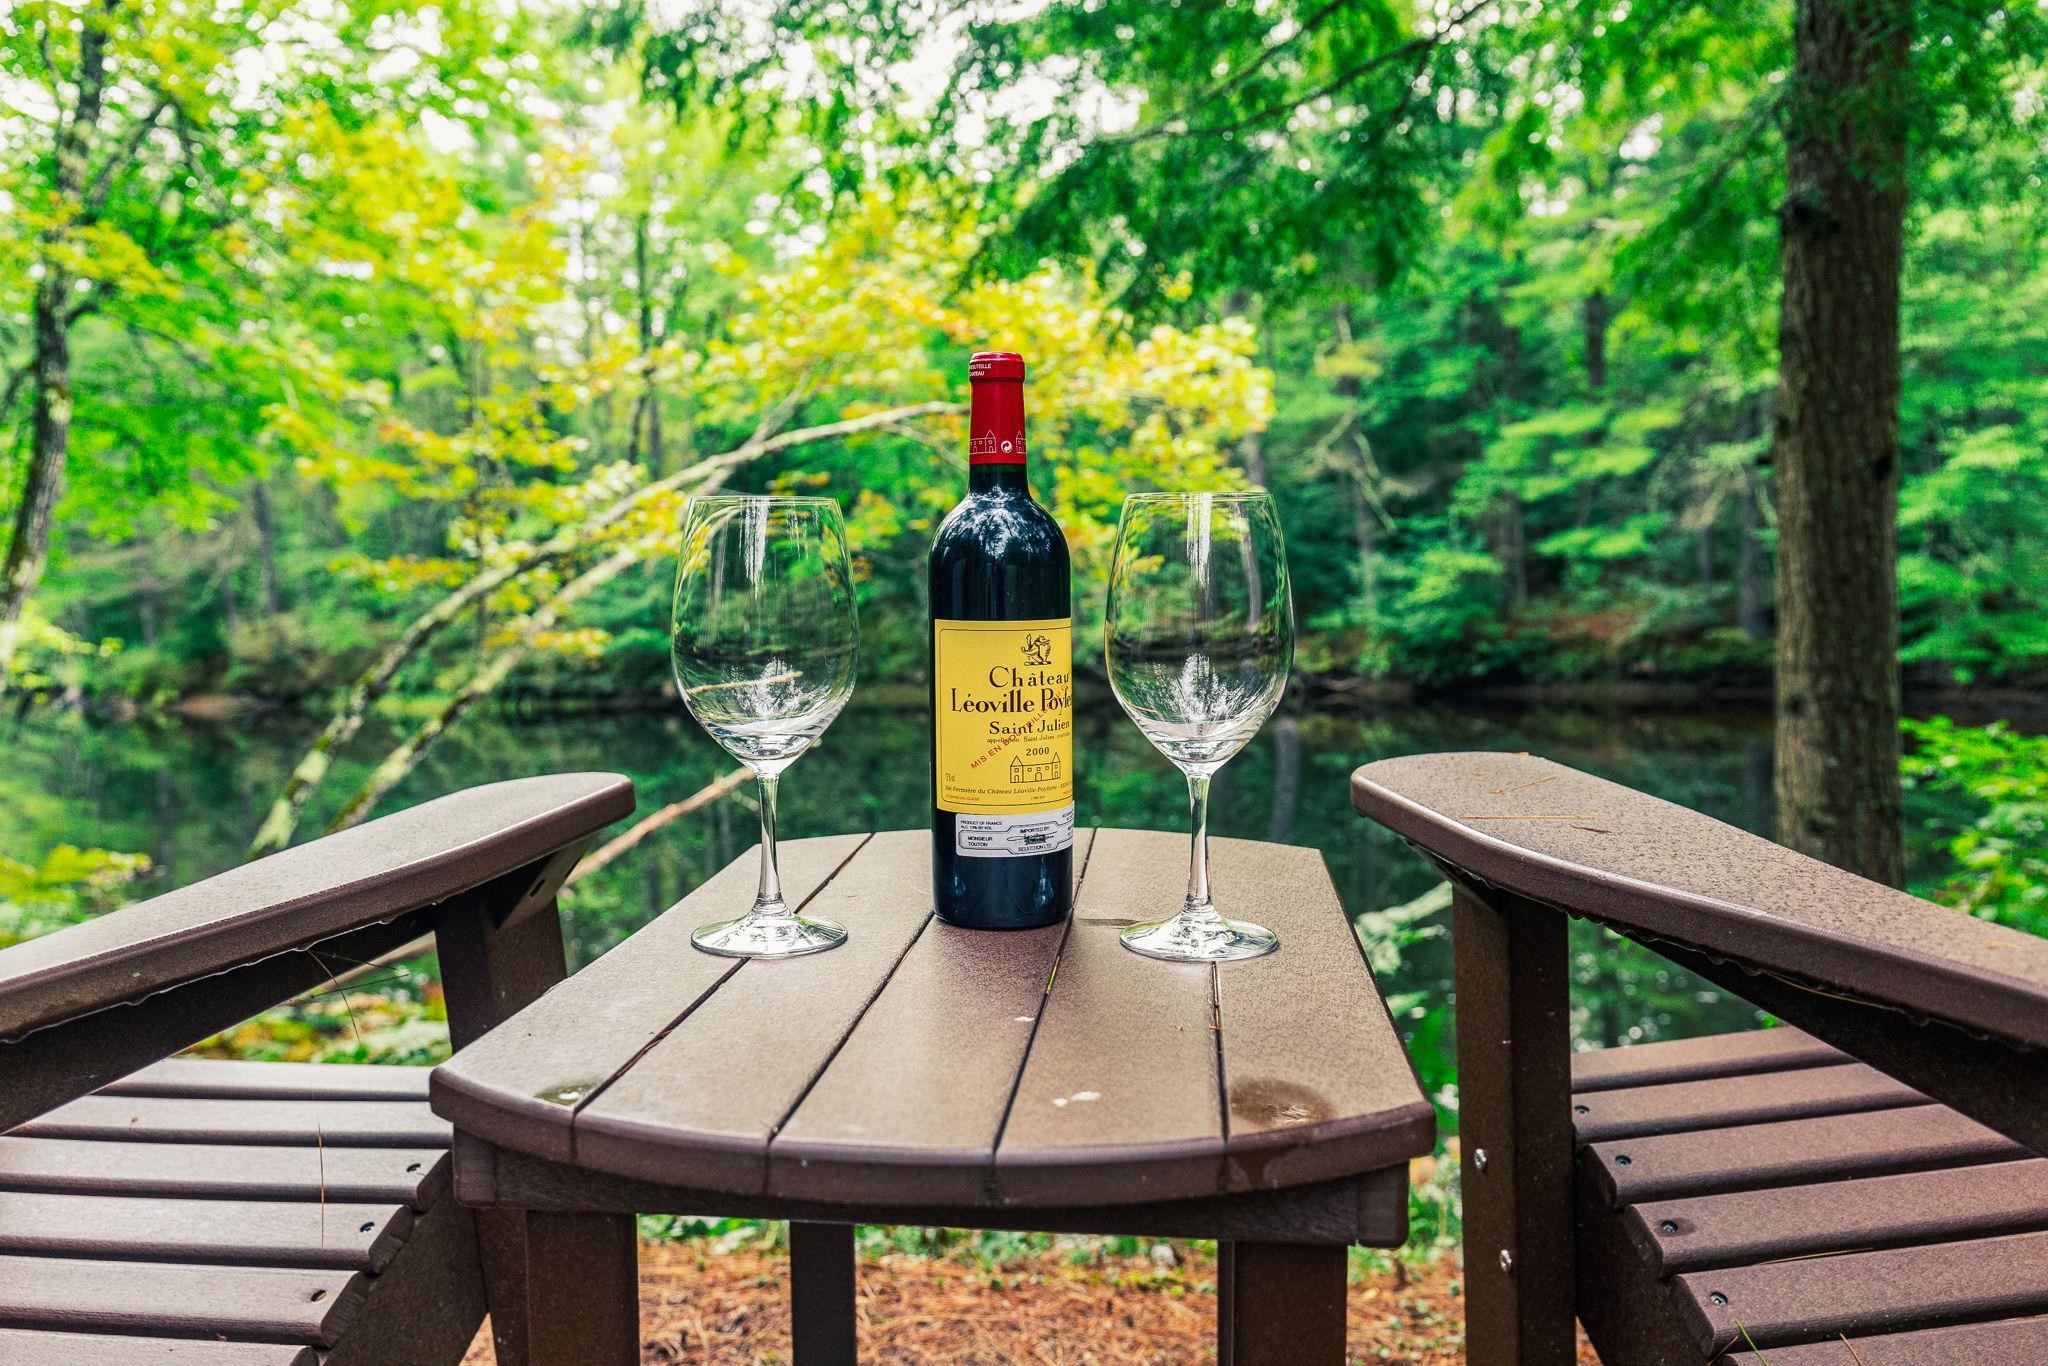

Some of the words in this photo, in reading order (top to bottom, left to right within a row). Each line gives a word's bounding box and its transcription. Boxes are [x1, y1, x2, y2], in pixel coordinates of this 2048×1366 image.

[989, 665, 1069, 688] Château
[951, 688, 1035, 713] Léoville
[1041, 687, 1072, 716] Poyfe
[989, 720, 1033, 735] Saint
[1037, 719, 1070, 733] Julien
[970, 754, 987, 770] MIS
[988, 745, 1002, 757] EN
[1025, 746, 1050, 757] 2000
[1018, 844, 1044, 852] SELECTION
